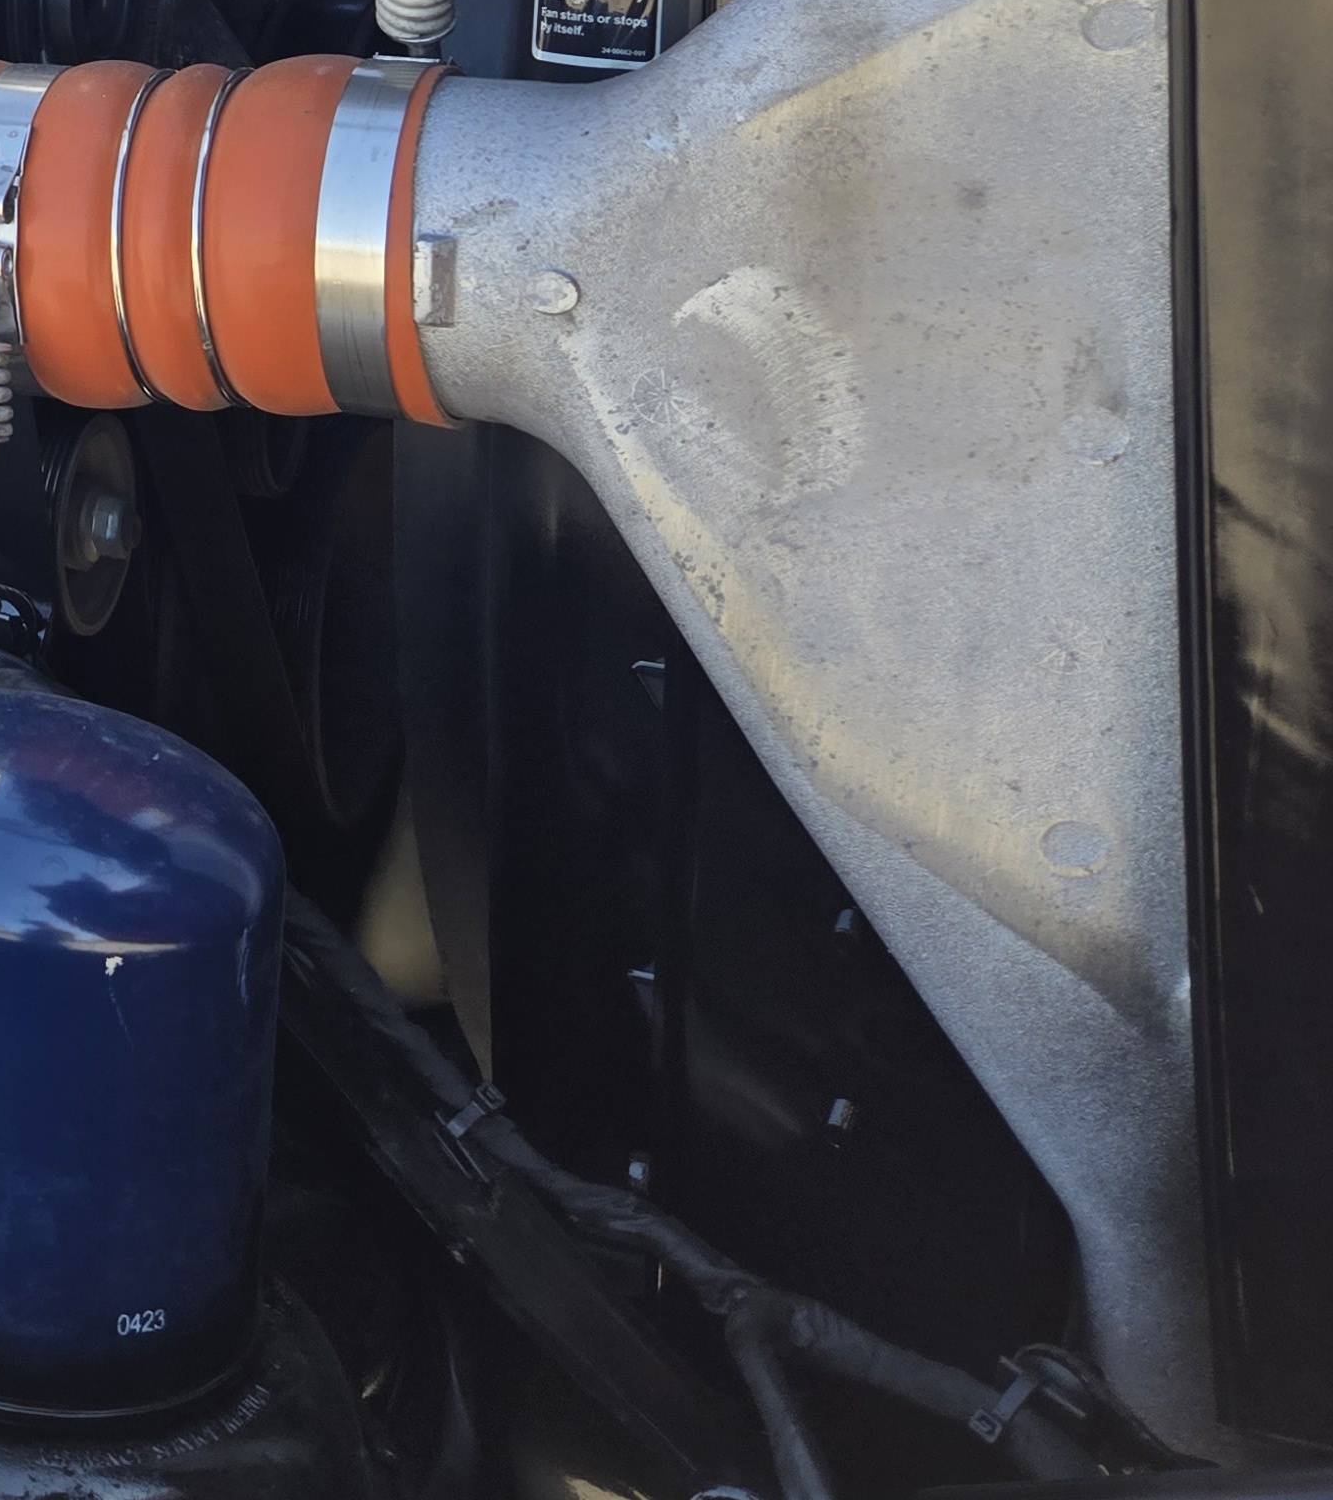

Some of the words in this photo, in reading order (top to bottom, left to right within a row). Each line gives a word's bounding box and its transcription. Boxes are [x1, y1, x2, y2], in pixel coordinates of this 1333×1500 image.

[540, 21, 552, 34] by
[554, 23, 585, 36] itself.
[541, 7, 558, 19] Fan
[560, 11, 594, 23] starts
[597, 15, 612, 24] or
[613, 16, 648, 29] stops
[117, 1308, 165, 1336] 0423
